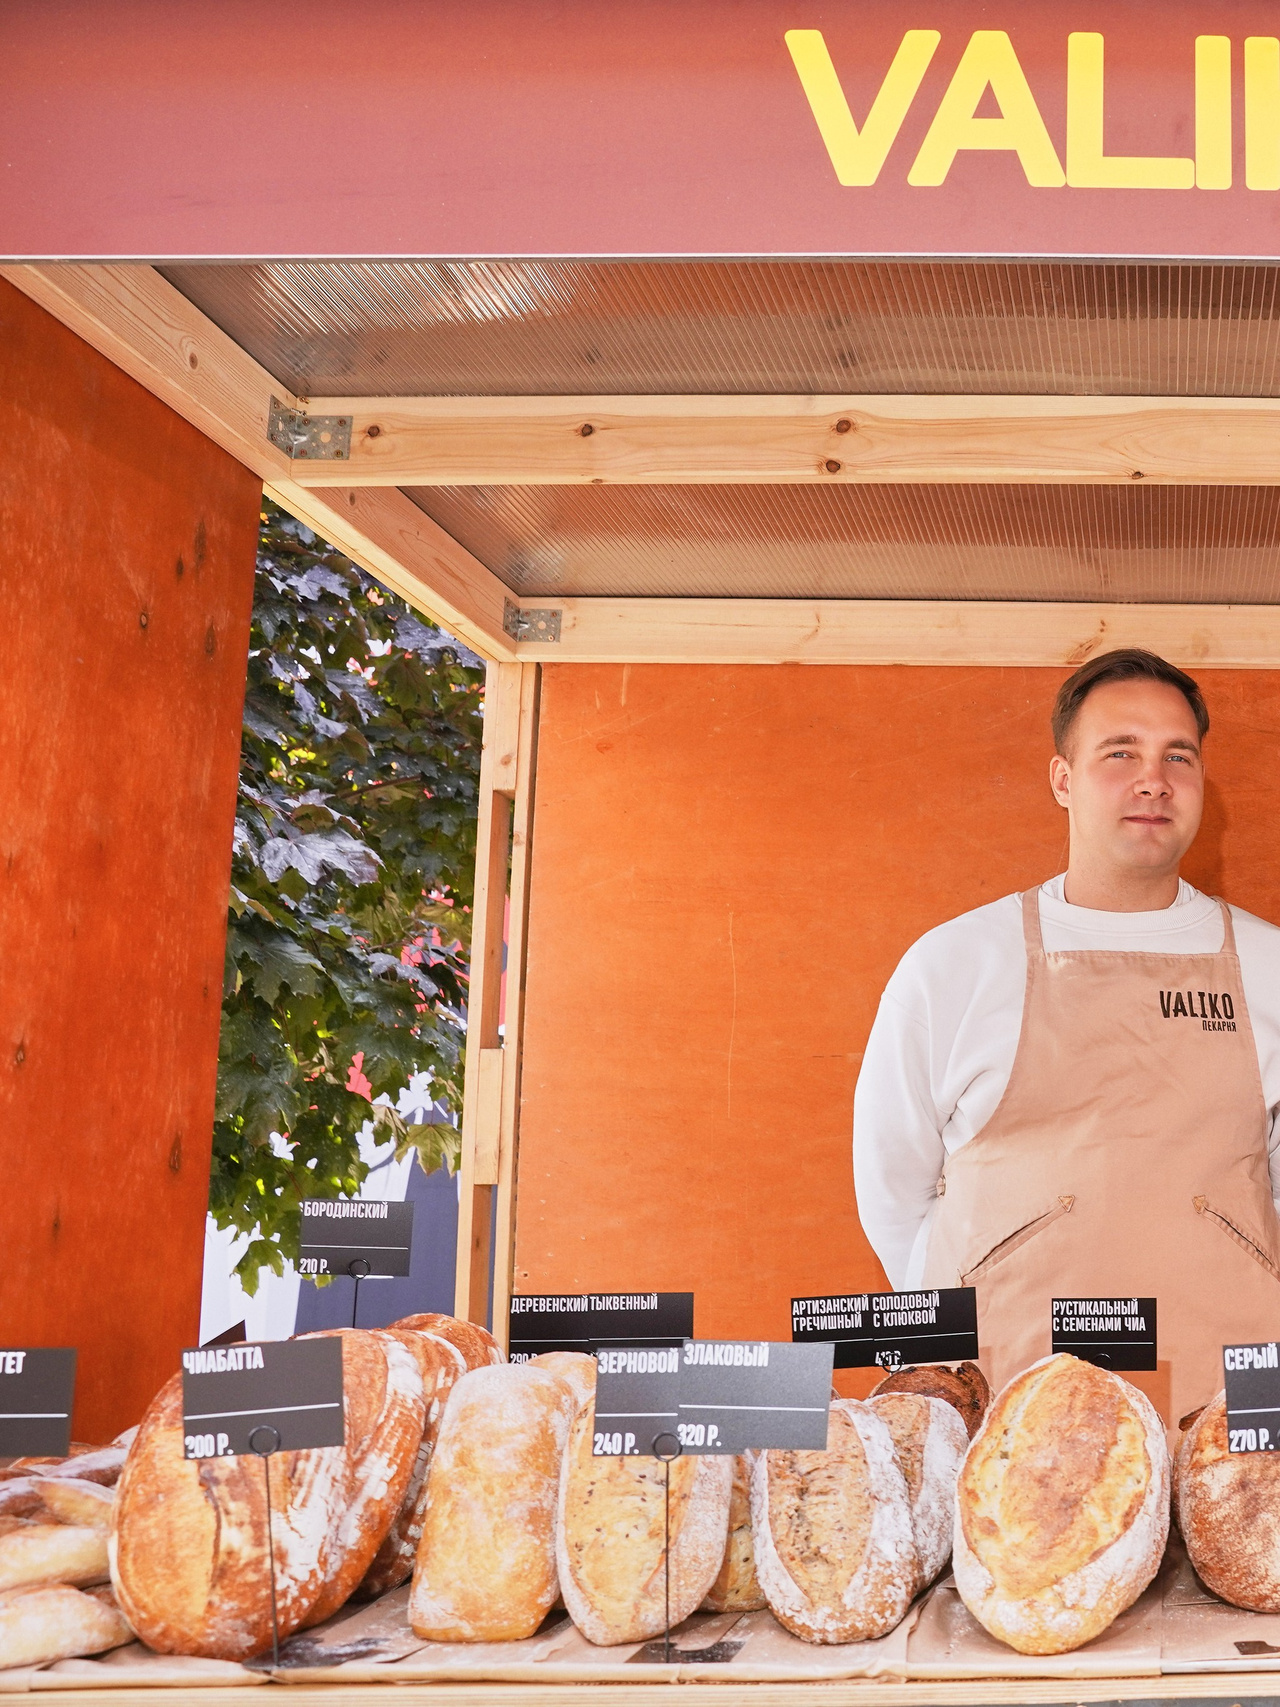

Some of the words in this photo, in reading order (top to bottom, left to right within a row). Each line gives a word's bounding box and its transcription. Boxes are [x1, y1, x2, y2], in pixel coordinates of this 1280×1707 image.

[1159, 991, 1235, 1019] VALIKO
[1202, 1020, 1237, 1032] ПЕКАРНЯ
[303, 1201, 389, 1219] БОРОДИНСКИЙ
[299, 1258, 318, 1274] 210
[510, 1293, 588, 1313] ДЕРЕВЕНСКИЙ
[589, 1292, 659, 1311] ТЫКВЕННЫЙ
[792, 1294, 870, 1316] АРТИЗАНСКИЙ
[872, 1291, 940, 1312] СОЛОДОВЫЙ
[1052, 1298, 1138, 1316] РУСТИКАЛЬНЫЙ
[793, 1311, 863, 1332] ГРЕЧИШНЫЙ
[873, 1313, 881, 1327] С
[882, 1309, 937, 1327] КЛЮКВОЙ
[1052, 1317, 1060, 1332] С
[1062, 1317, 1122, 1332] СЕМЕНАМИ
[1124, 1317, 1146, 1332] ЧИА
[183, 1345, 264, 1374] ЧИАБАТТА
[598, 1347, 679, 1374] ЗЕРНОВОЙ
[683, 1342, 770, 1367] ЗЛАКОВЫЙ
[1224, 1342, 1278, 1370] СЕРЫЙ
[593, 1432, 622, 1455] 240
[677, 1423, 705, 1446] 320
[1229, 1428, 1257, 1452] 270
